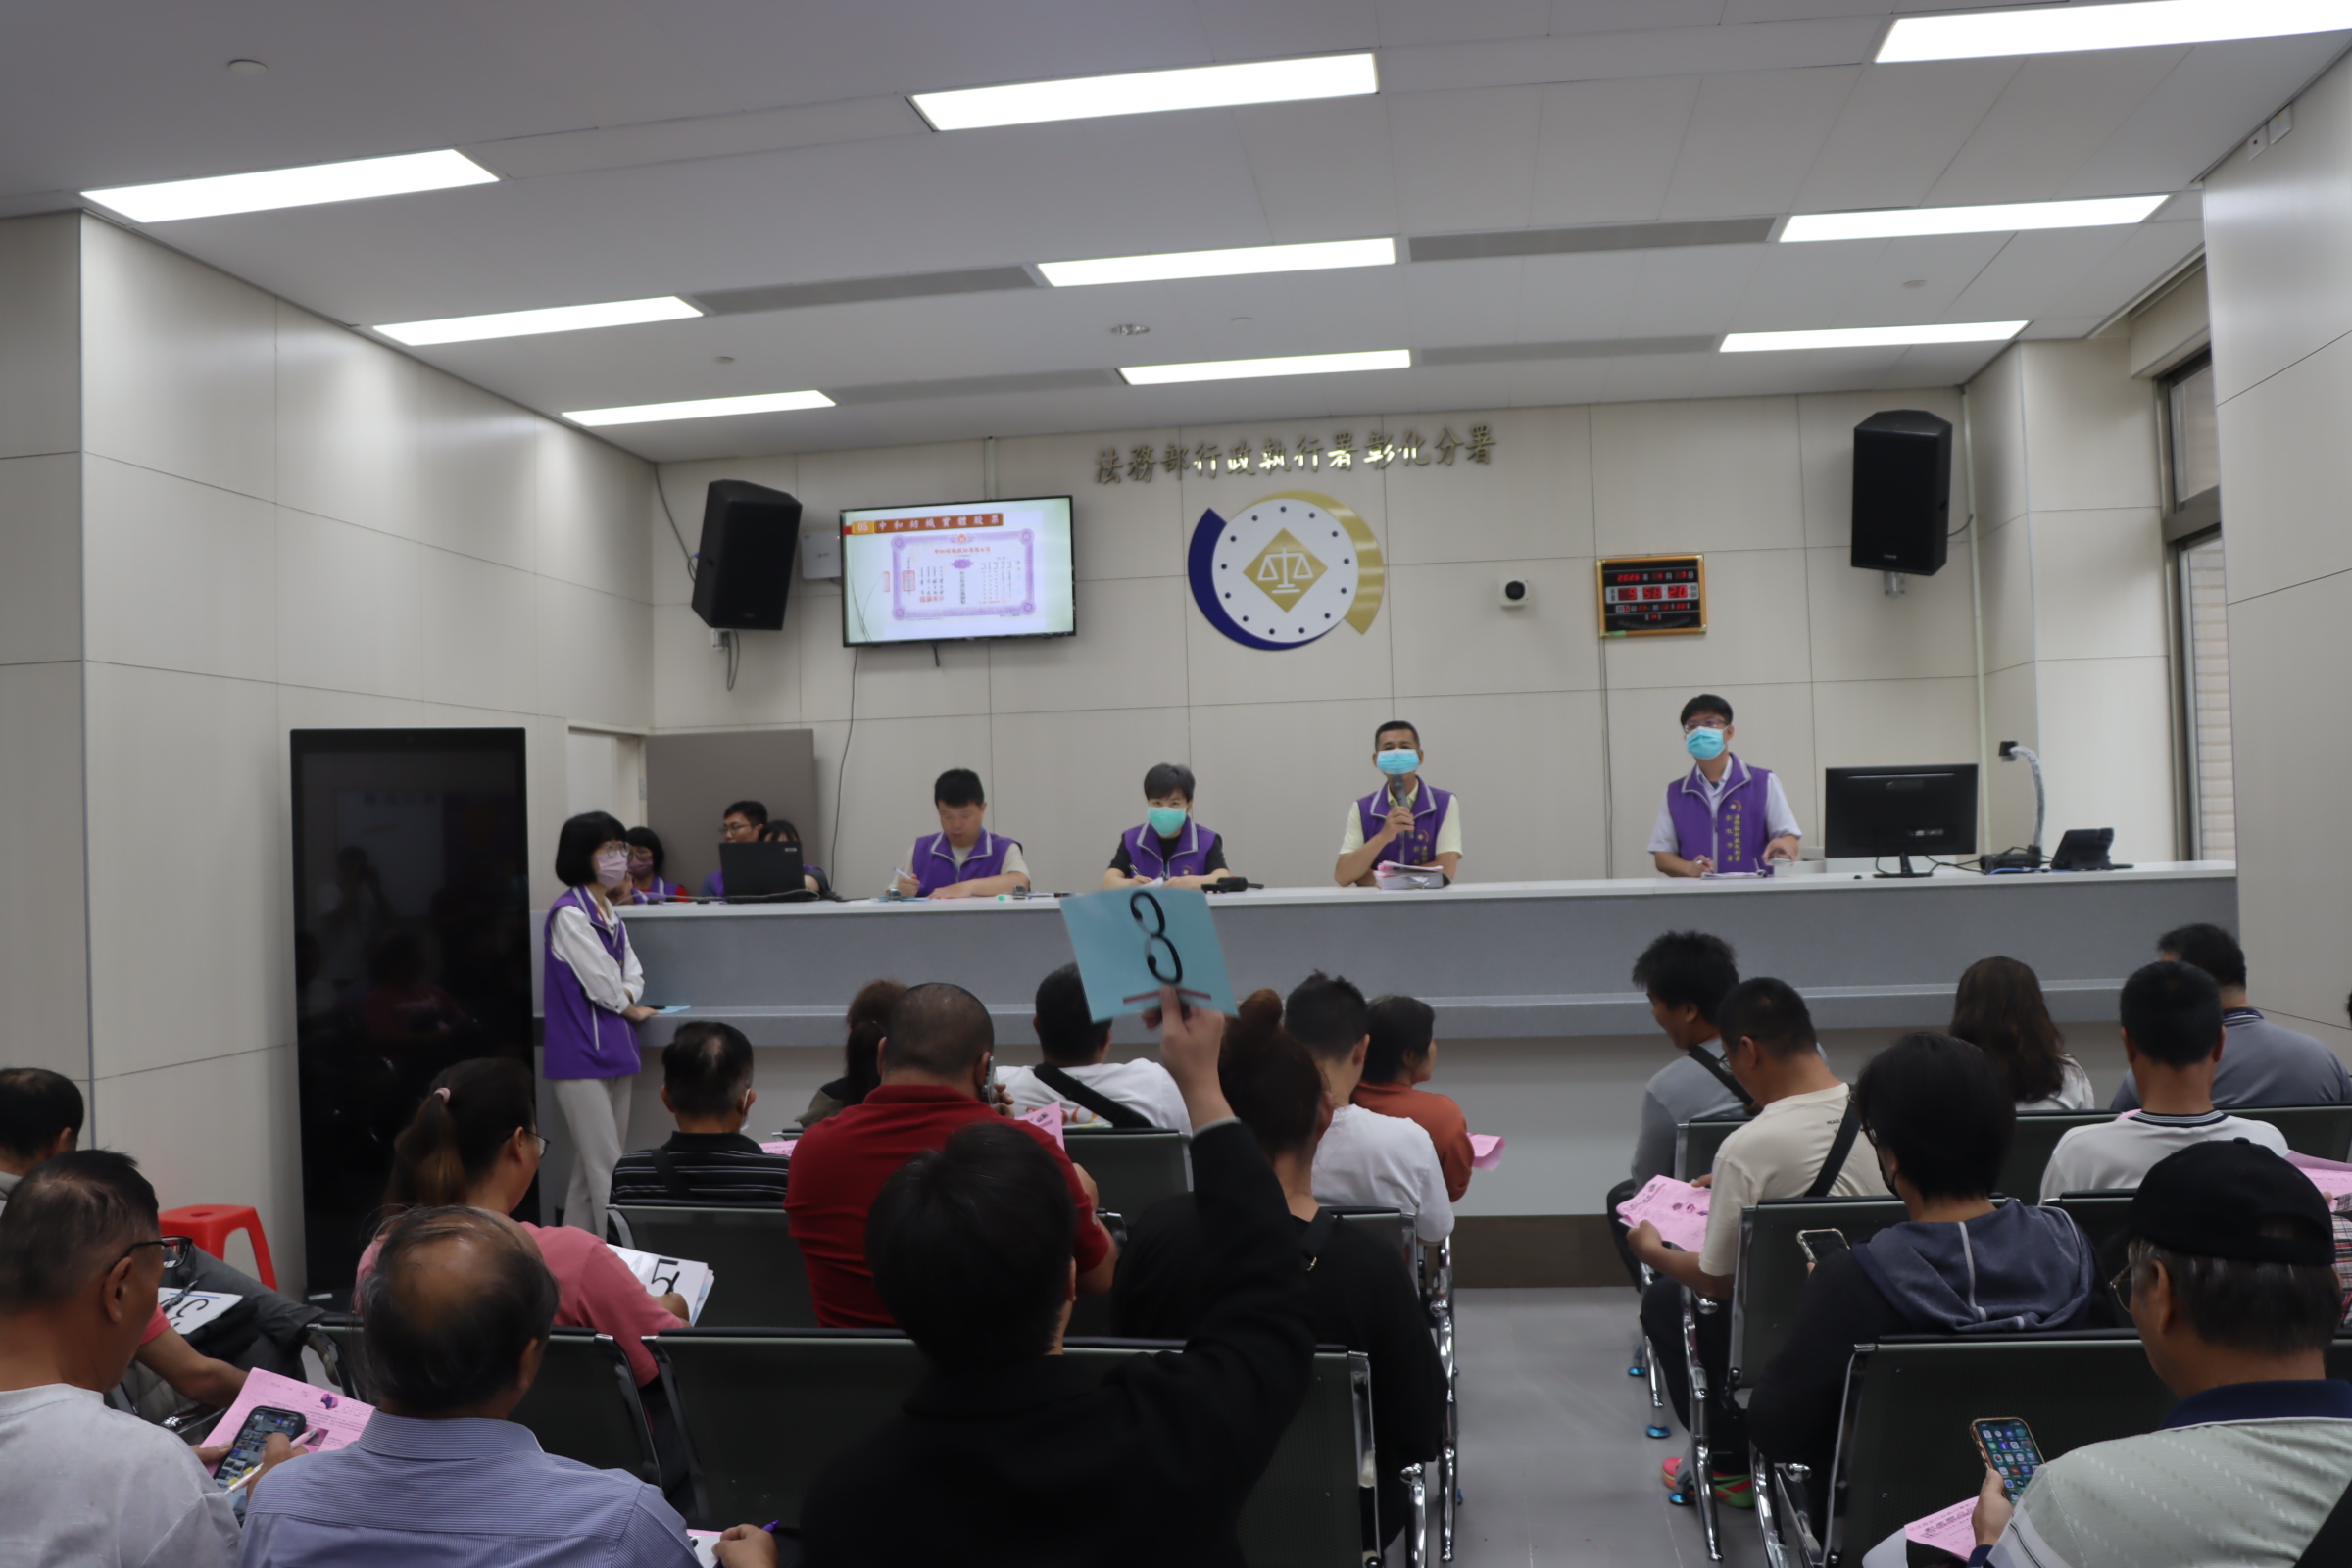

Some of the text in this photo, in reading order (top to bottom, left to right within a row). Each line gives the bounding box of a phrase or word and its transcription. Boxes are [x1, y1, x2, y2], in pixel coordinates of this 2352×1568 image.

[1095, 424, 1496, 484] 法務部行政執行署彰化分署
[858, 521, 868, 532] 05
[879, 513, 1000, 531] 中和紡織實體股票
[1617, 573, 1641, 582] 2026
[1629, 588, 1637, 600] 9
[1668, 586, 1688, 598] 20
